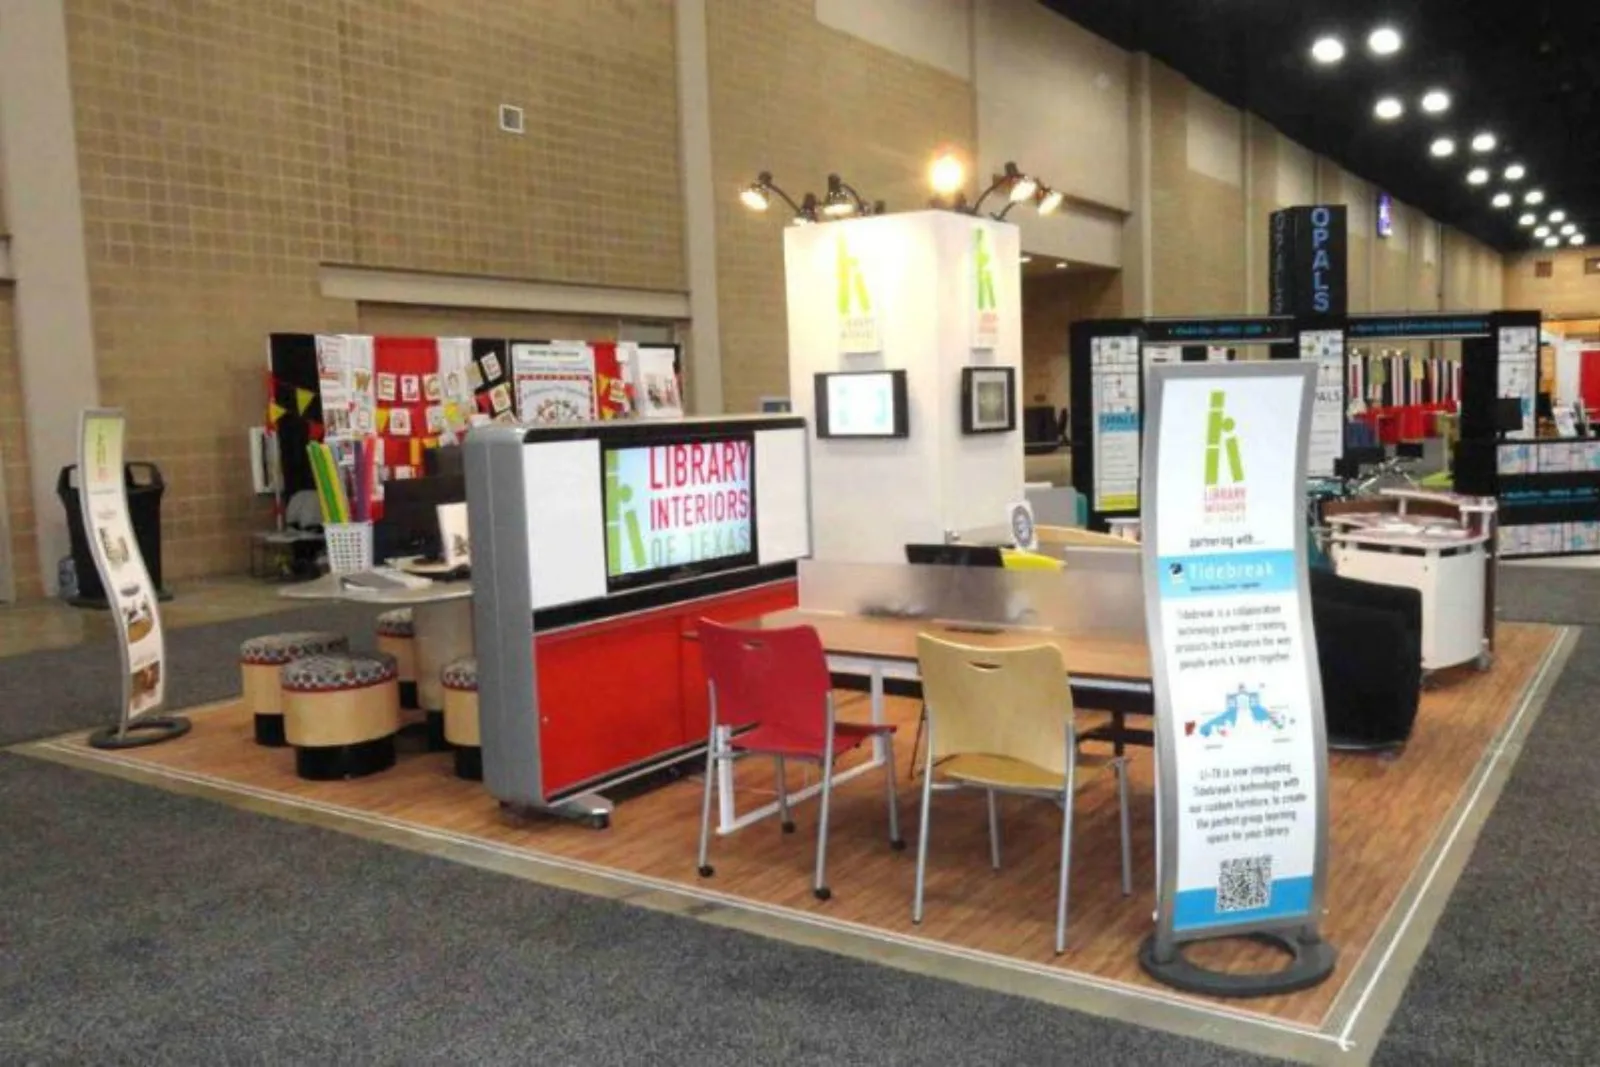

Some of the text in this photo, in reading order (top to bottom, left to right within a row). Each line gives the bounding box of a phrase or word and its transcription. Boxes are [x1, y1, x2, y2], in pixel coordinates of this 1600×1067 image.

[1310, 208, 1330, 312] OPALS
[649, 439, 749, 490] LIBRARY
[650, 488, 749, 531] INTERIORS
[1204, 487, 1247, 501] LIBRARY
[651, 526, 750, 568] OF TEXAS
[1189, 536, 1234, 549] partnering
[1188, 561, 1275, 581] Tidebreak
